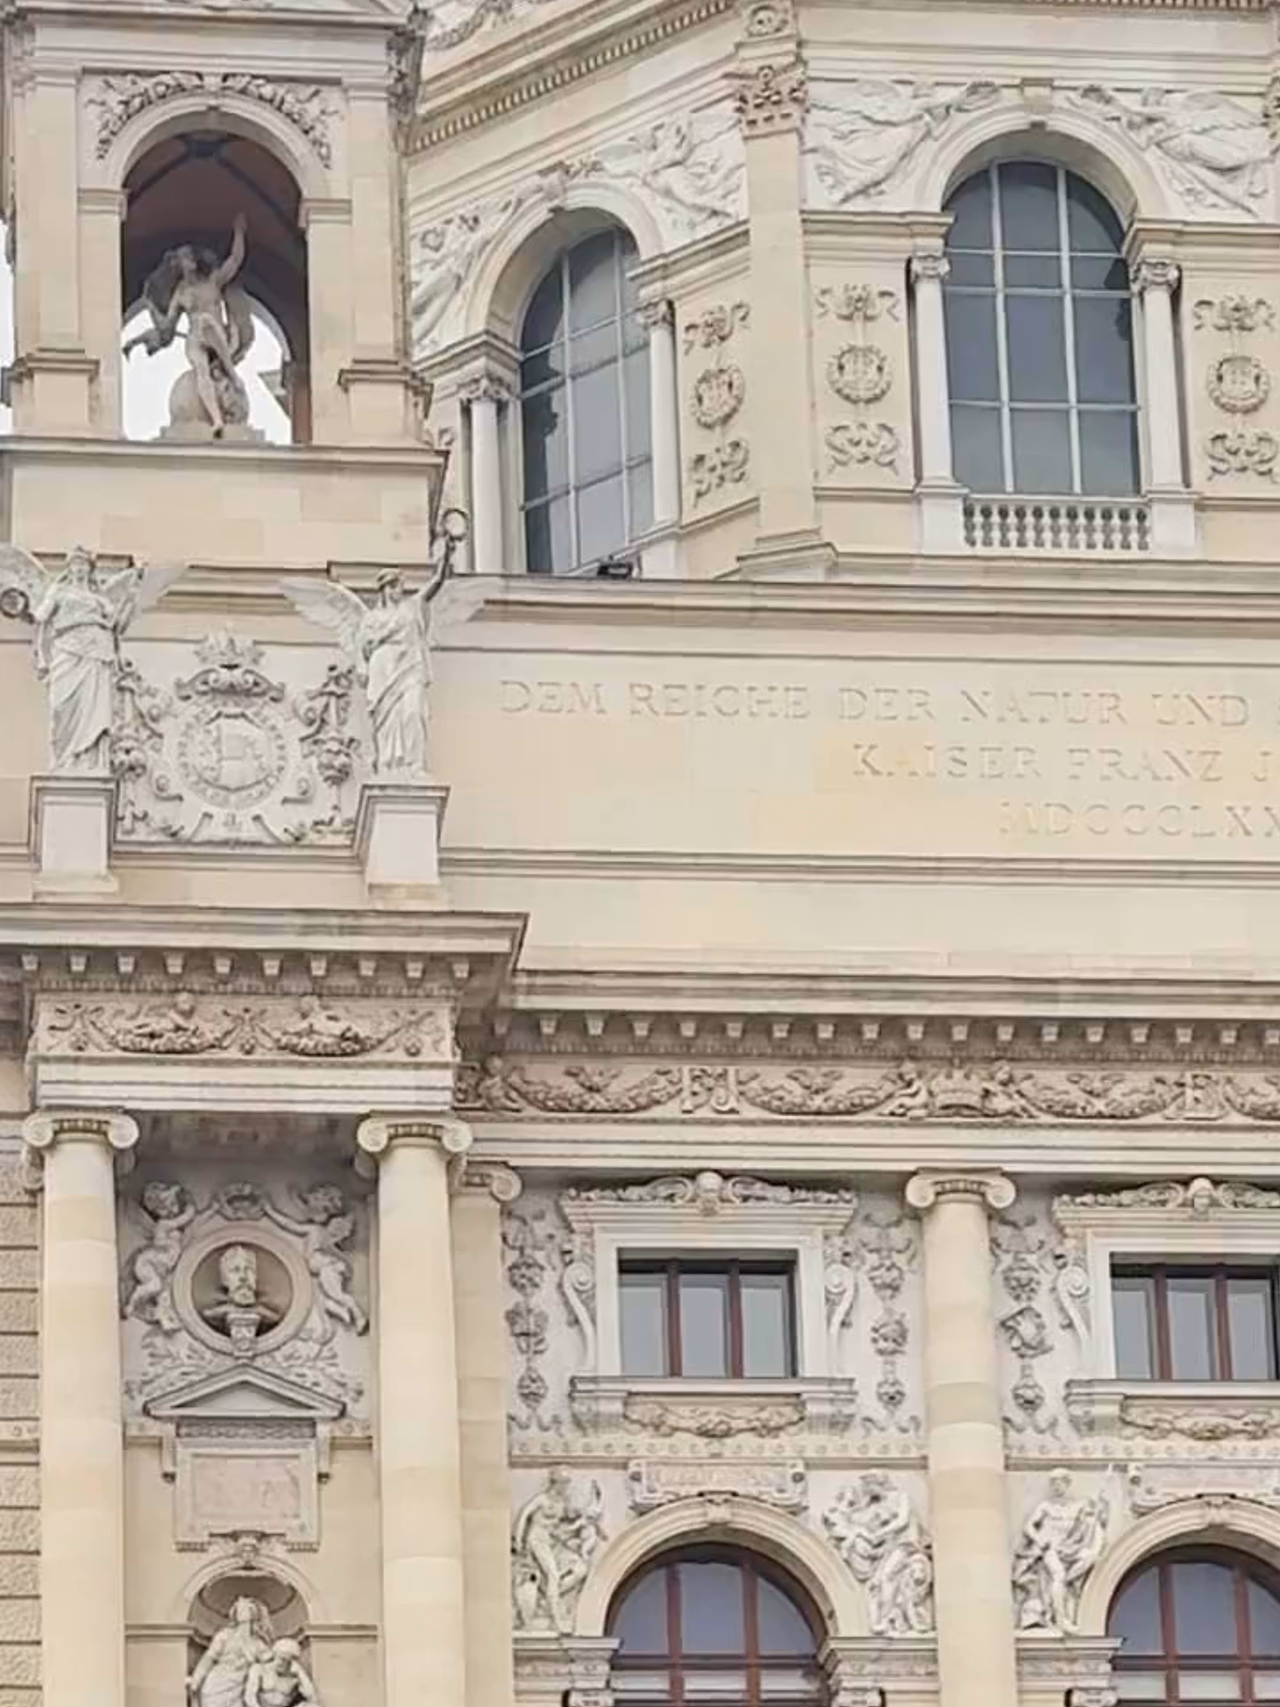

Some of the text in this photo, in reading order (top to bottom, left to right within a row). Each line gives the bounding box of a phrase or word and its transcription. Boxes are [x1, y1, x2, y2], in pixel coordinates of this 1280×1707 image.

[498, 679, 608, 715] DEM
[627, 682, 812, 719] REICHE
[837, 687, 937, 721] DER
[960, 689, 1128, 725] NATUR
[1150, 693, 1250, 727] UND
[1066, 747, 1224, 782] FRANZ
